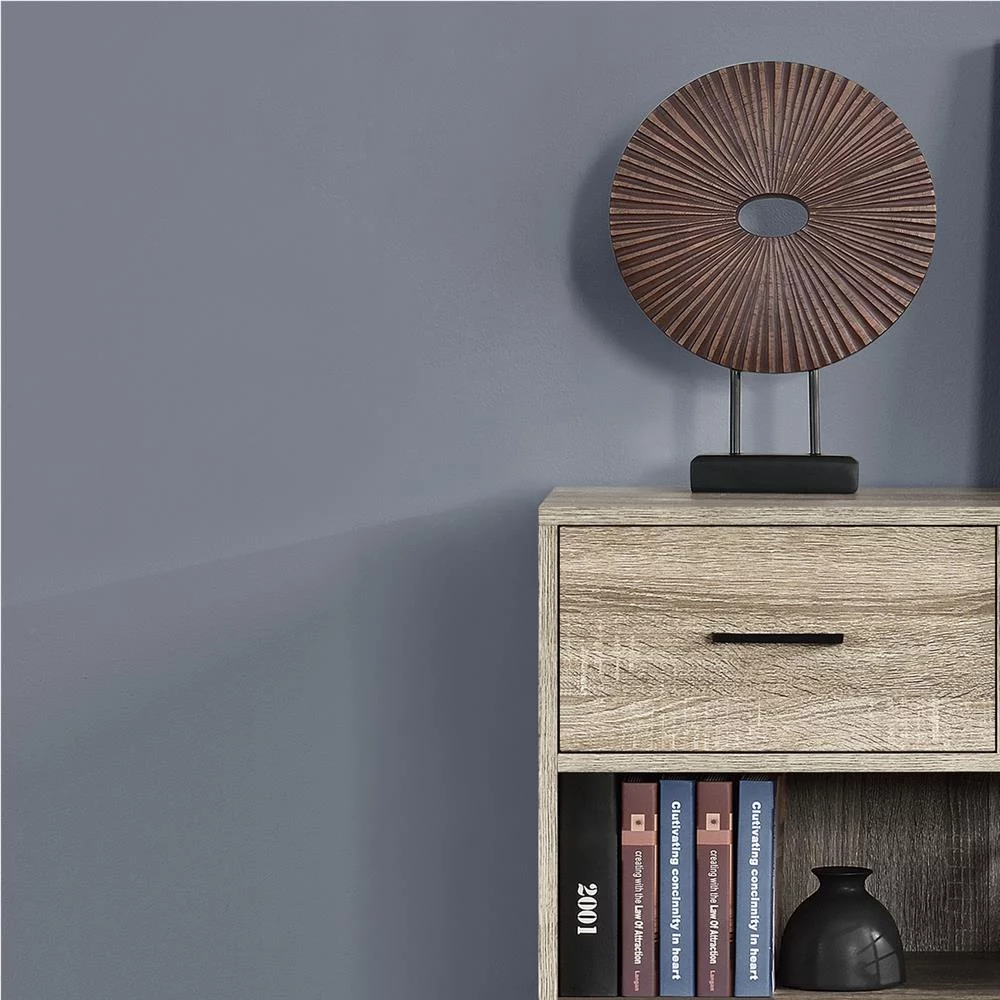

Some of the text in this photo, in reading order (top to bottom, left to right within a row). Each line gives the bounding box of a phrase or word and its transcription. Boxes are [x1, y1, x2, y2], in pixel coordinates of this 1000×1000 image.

[577, 883, 598, 935] 2001
[633, 850, 644, 965] creating with the Law Of Attraction
[669, 868, 681, 930] concinnity
[708, 850, 719, 965] creating with the Law Of Attraction
[748, 868, 760, 931] concinnity
[671, 933, 681, 945] in
[671, 947, 681, 980] heart
[749, 933, 759, 945] in
[749, 947, 760, 980] heart
